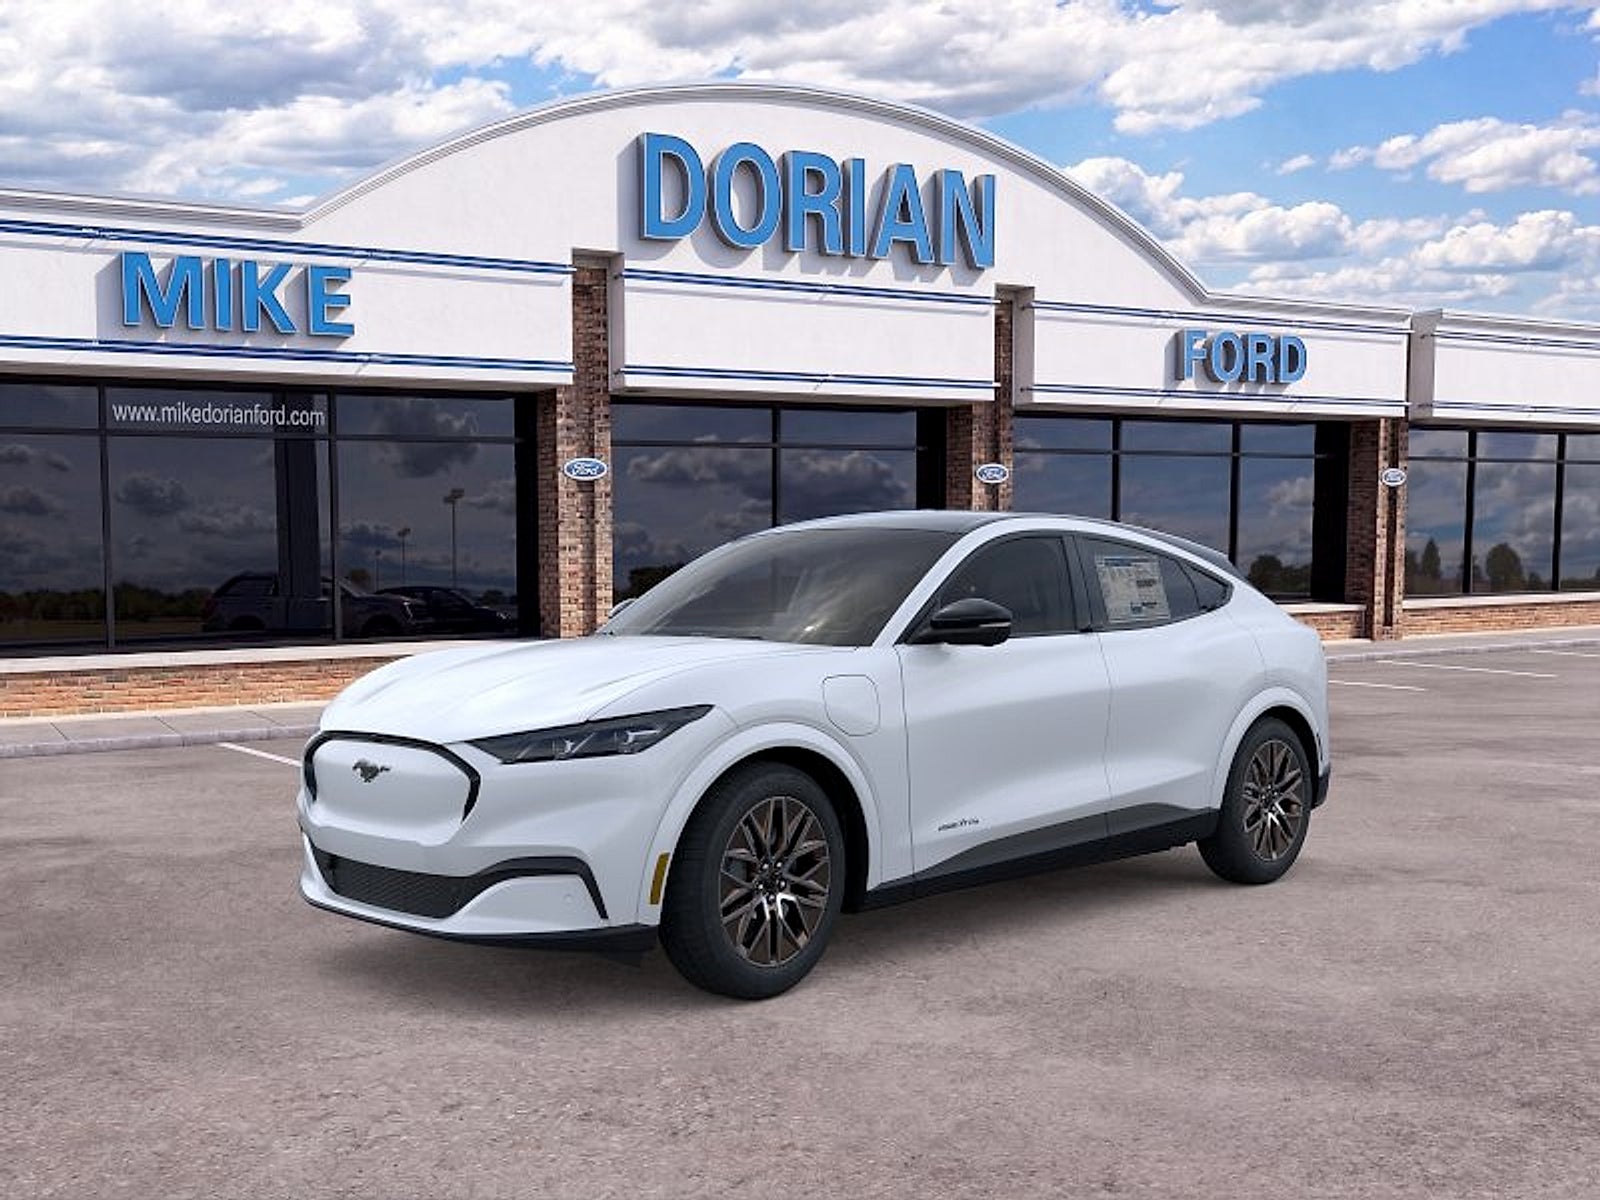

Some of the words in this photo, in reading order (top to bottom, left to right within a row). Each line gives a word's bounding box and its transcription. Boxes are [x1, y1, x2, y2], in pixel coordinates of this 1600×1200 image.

[640, 131, 996, 269] DORIAN
[121, 251, 355, 337] MIKE
[1178, 329, 1308, 383] FORD
[112, 401, 325, 427] www.mikedorianford.com
